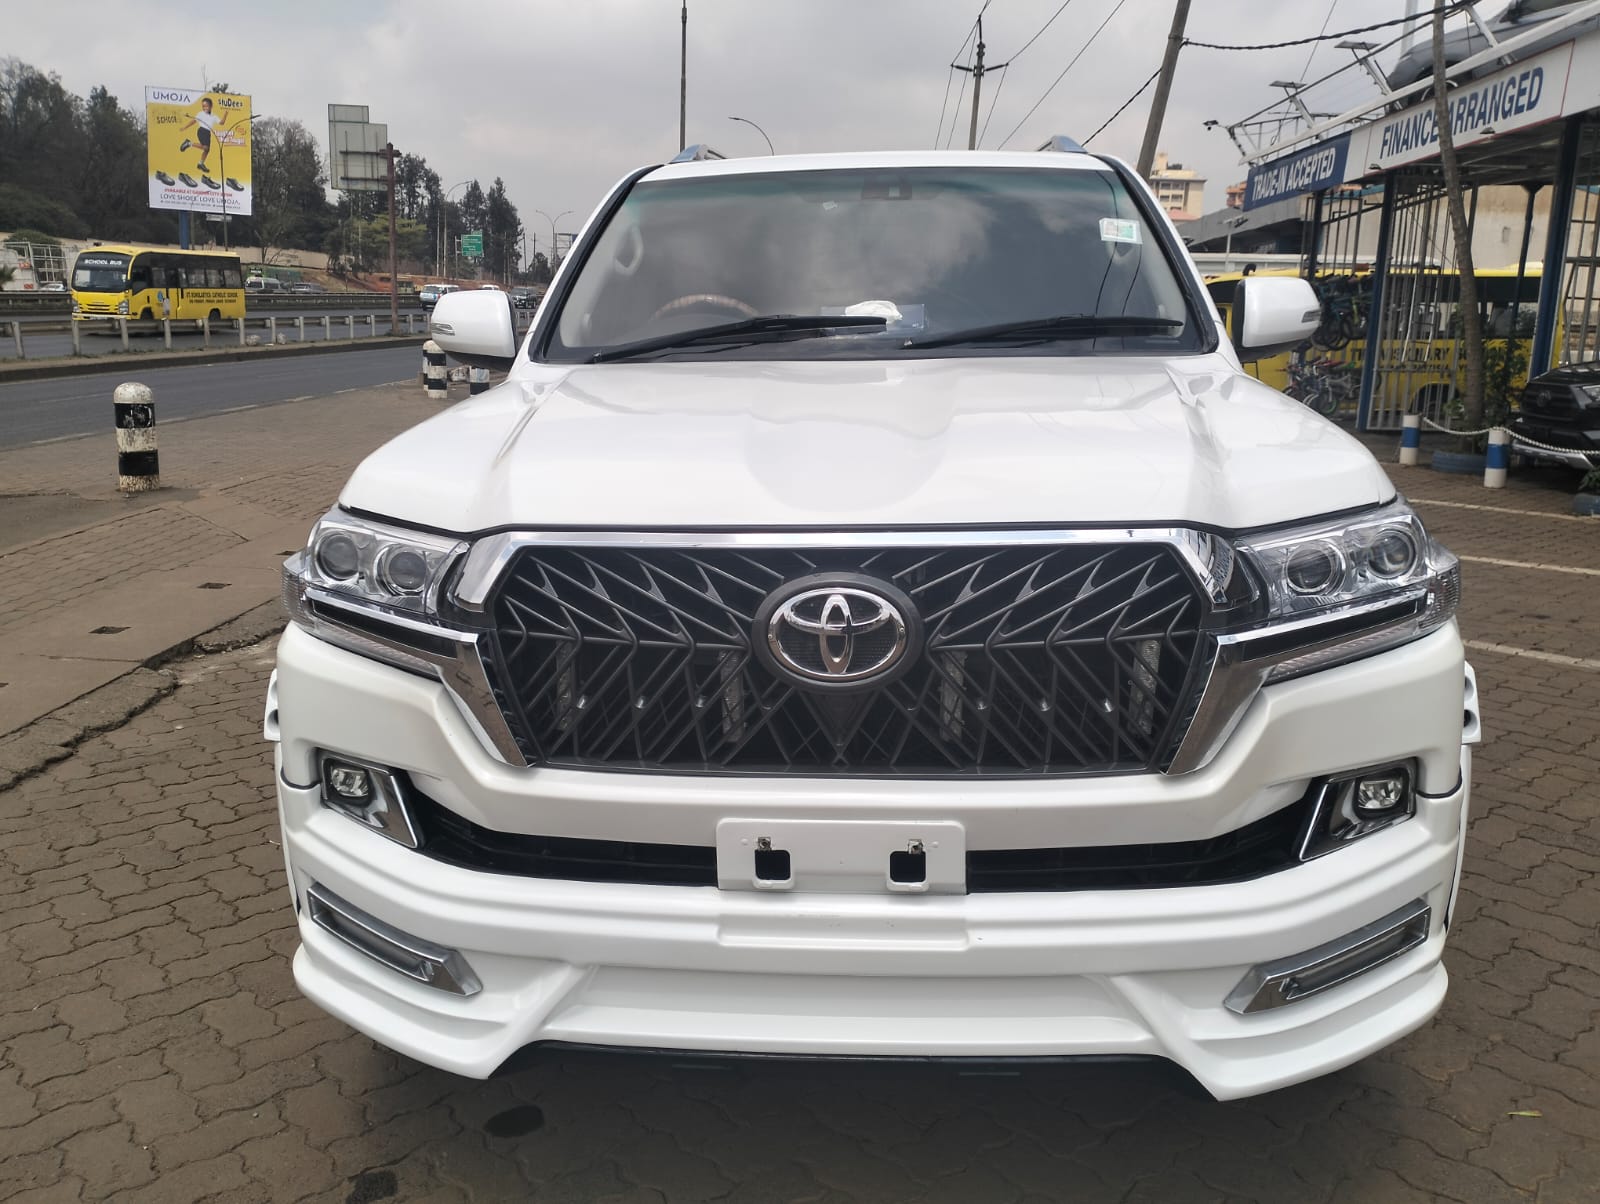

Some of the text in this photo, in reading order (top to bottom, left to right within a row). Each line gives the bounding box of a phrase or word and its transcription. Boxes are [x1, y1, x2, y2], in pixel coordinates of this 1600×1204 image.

[152, 90, 191, 103] UMOJA
[1378, 109, 1439, 160] FINANCE
[1252, 146, 1336, 201] TRADE-IN ACCEPTED
